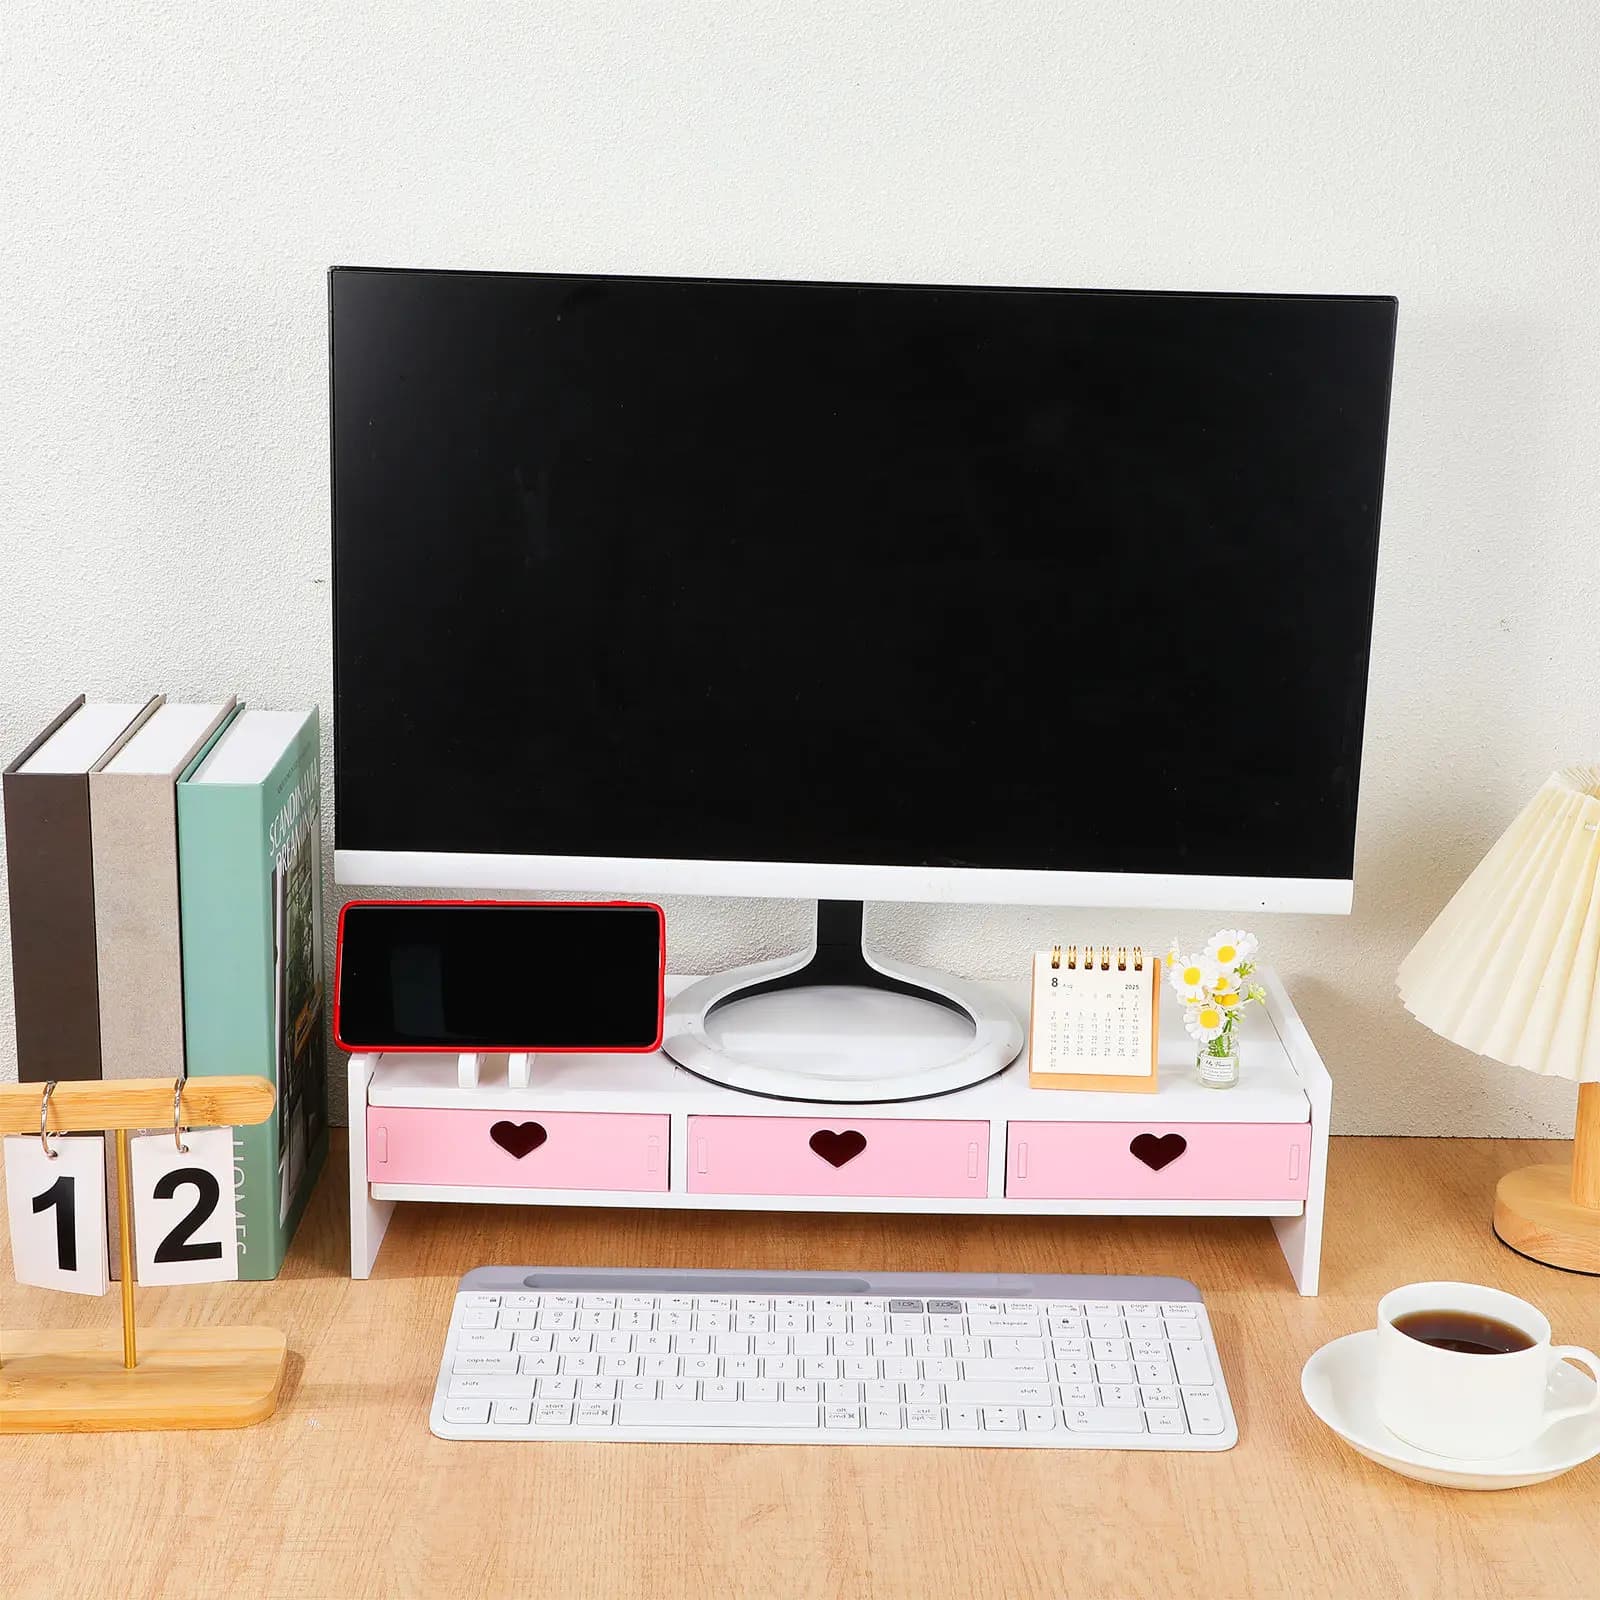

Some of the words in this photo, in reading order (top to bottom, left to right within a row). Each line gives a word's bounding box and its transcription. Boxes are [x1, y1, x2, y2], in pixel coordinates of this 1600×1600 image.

[1051, 978, 1058, 988] 8
[32, 1175, 77, 1271] 1
[153, 1167, 223, 1264] 2
